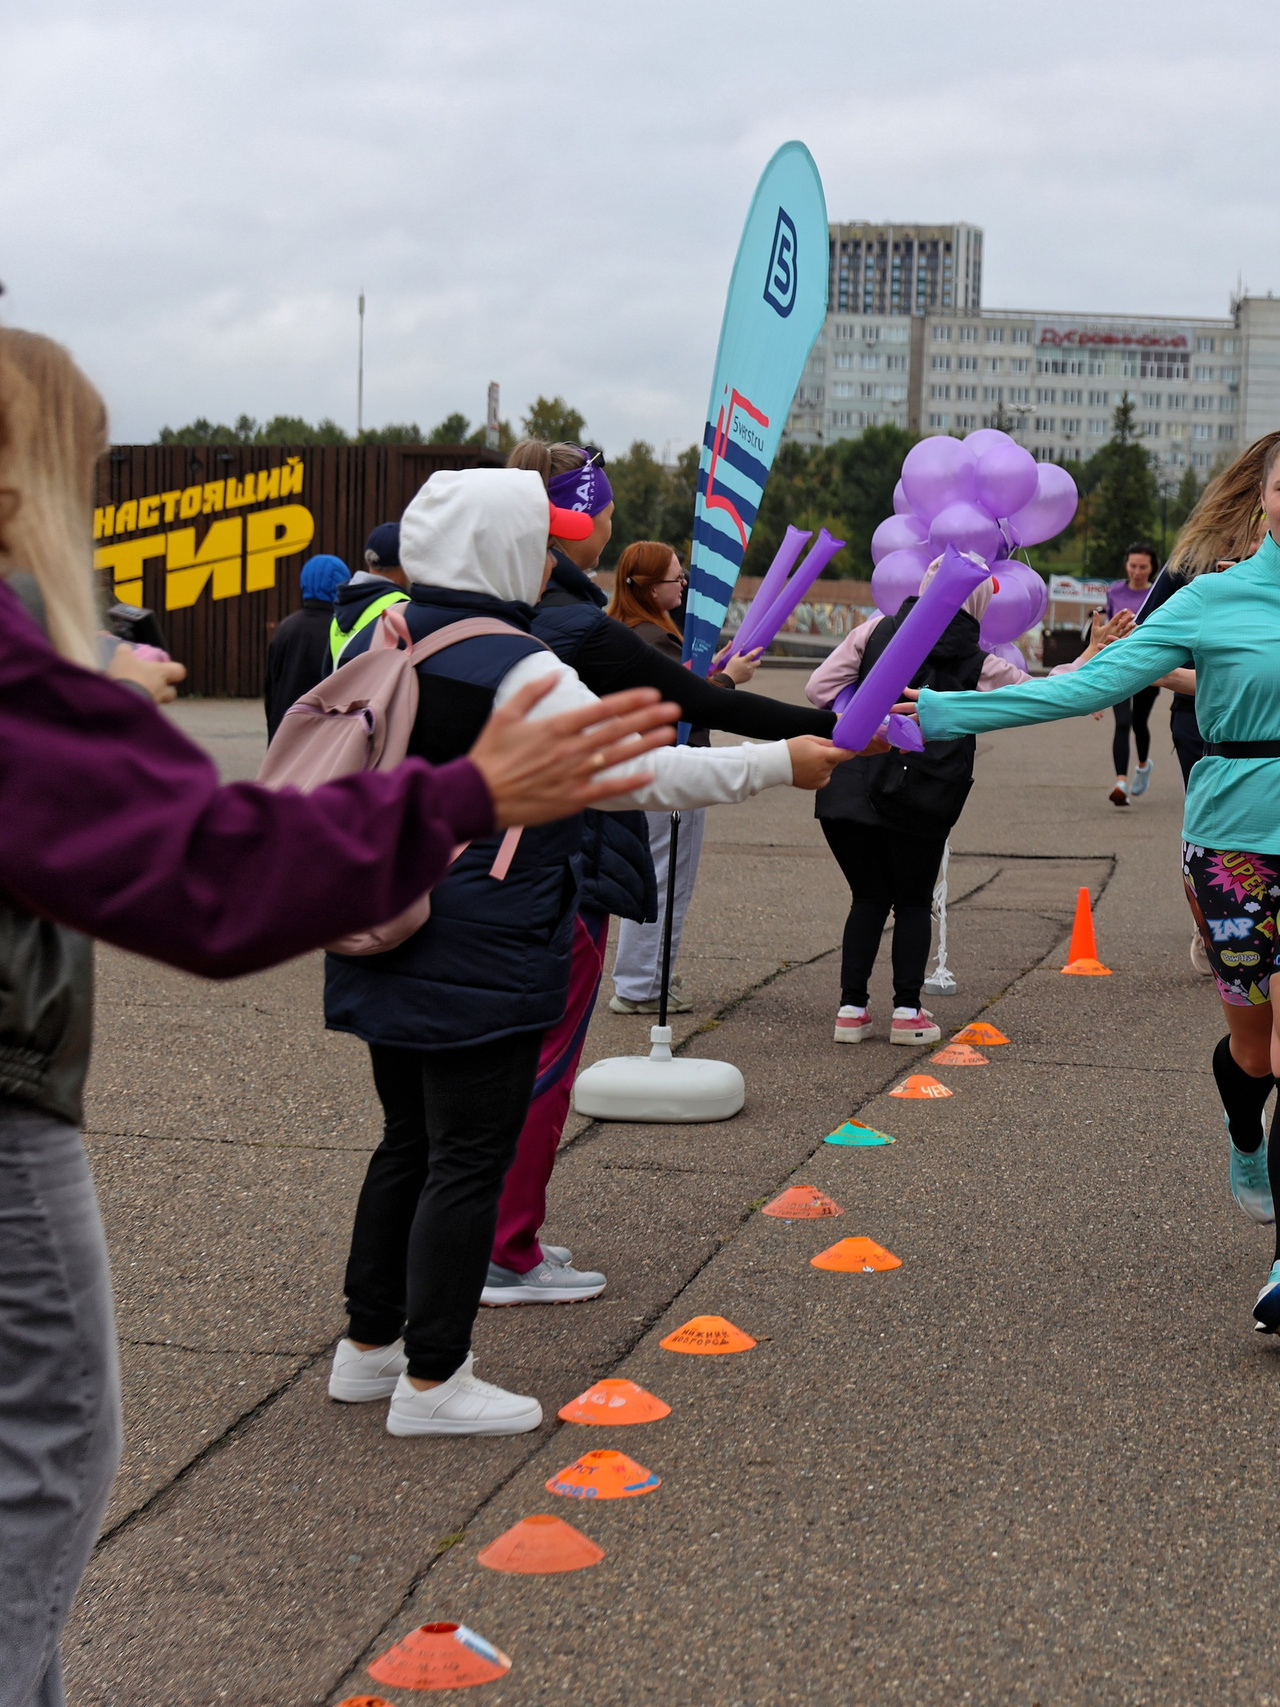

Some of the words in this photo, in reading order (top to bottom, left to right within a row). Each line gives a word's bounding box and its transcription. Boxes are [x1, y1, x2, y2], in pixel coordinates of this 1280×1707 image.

[732, 414, 764, 452] 5verst.ru
[92, 455, 305, 540] НАСТОЯЩИЙ
[92, 503, 315, 612] ТИР
[1214, 848, 1268, 901] UPER
[1207, 918, 1254, 941] ZAP
